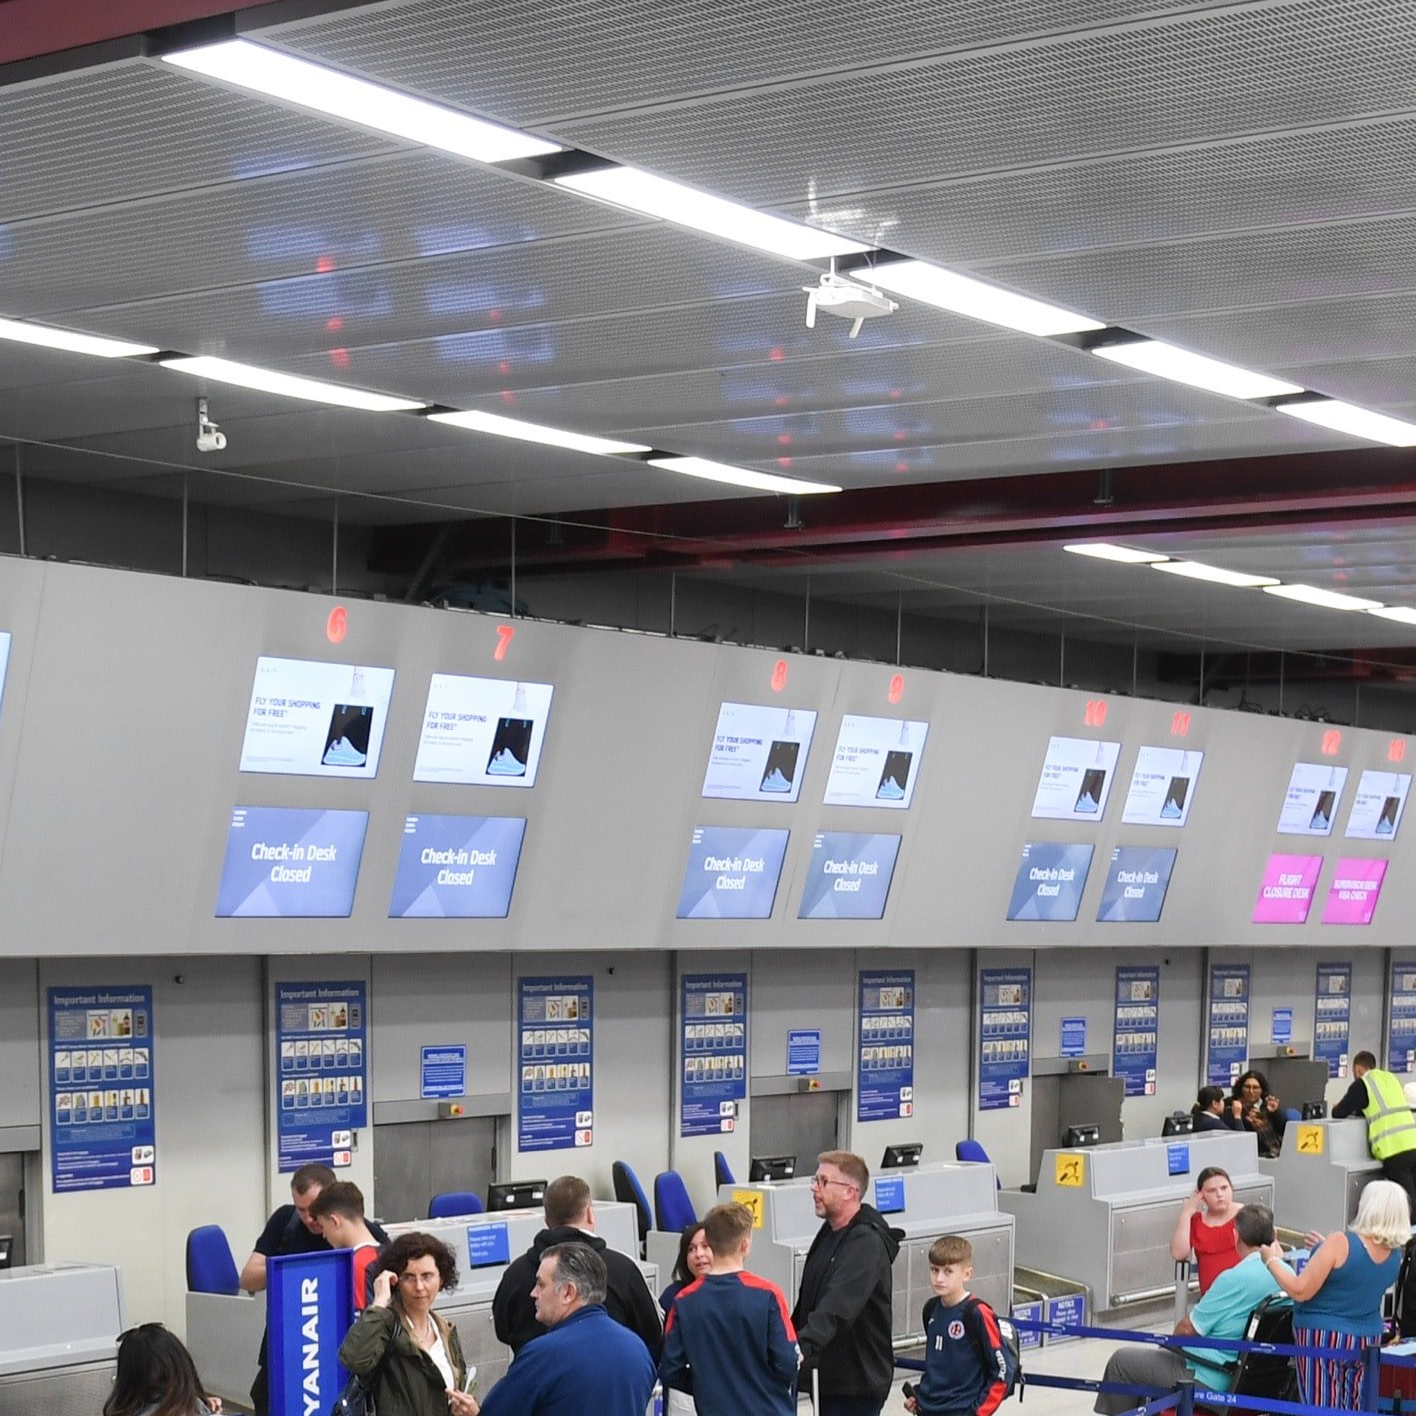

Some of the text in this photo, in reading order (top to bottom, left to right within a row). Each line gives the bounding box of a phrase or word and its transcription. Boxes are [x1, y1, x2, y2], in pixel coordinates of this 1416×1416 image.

[326, 606, 348, 645] 6
[493, 624, 515, 662] 7
[770, 659, 789, 692] 8
[887, 673, 904, 704] 9
[1084, 699, 1109, 728] 10
[1170, 711, 1192, 737] 11
[250, 842, 337, 862] Check-in Desk
[420, 847, 497, 866] Check-in Desk
[703, 856, 765, 873] Check-in Desk
[823, 860, 879, 875] Check-in Desk
[270, 864, 312, 883] Closed
[437, 869, 474, 885] Closed
[1029, 867, 1075, 882] Check-in Desk
[1278, 873, 1303, 886] FLIGHT
[715, 875, 746, 890] Closed
[833, 877, 862, 892] Closed
[1036, 883, 1061, 897] Closed
[1262, 886, 1311, 899] CLOSURE DESK
[280, 988, 360, 1000] Important Information
[522, 981, 589, 994] Important Information
[53, 993, 145, 1007] Important Information
[1058, 1299, 1076, 1309] NOTICE
[1205, 1391, 1226, 1403] Gate
[1226, 1393, 1238, 1404] 24
